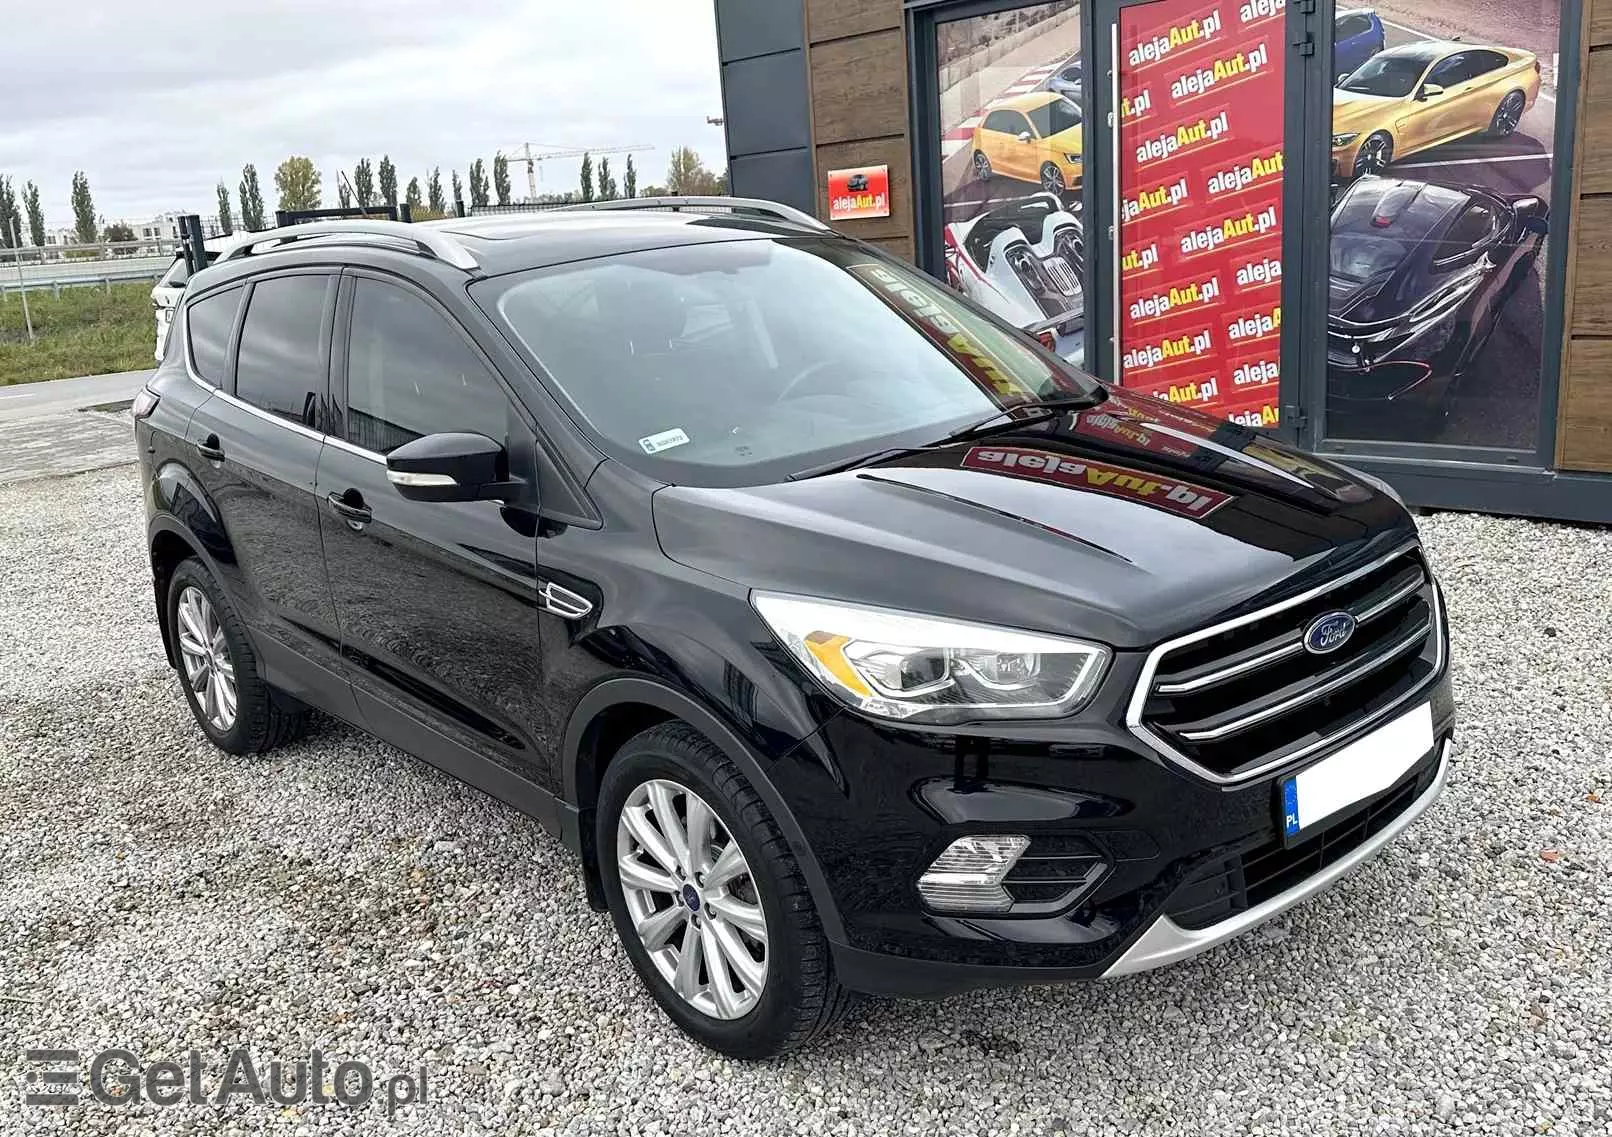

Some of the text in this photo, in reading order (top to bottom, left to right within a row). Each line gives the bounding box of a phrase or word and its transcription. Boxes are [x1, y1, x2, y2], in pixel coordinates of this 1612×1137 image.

[1129, 10, 1221, 66] alejaAut.pl
[1171, 44, 1267, 98] alejaAut.pl
[1136, 112, 1229, 163] alejaAut.pl
[1208, 151, 1284, 194] alejaAut
[833, 193, 885, 211] alejaAut.pl
[1121, 178, 1188, 222] jaAut.pl
[1181, 206, 1276, 253] alejaAut.pl
[1236, 258, 1281, 286] aleja
[1130, 277, 1219, 319] alejaAut.pl
[1123, 330, 1211, 368] alejaAut.pl
[1233, 354, 1280, 385] aleja
[1320, 621, 1349, 646] Ford
[1286, 815, 1298, 828] PL
